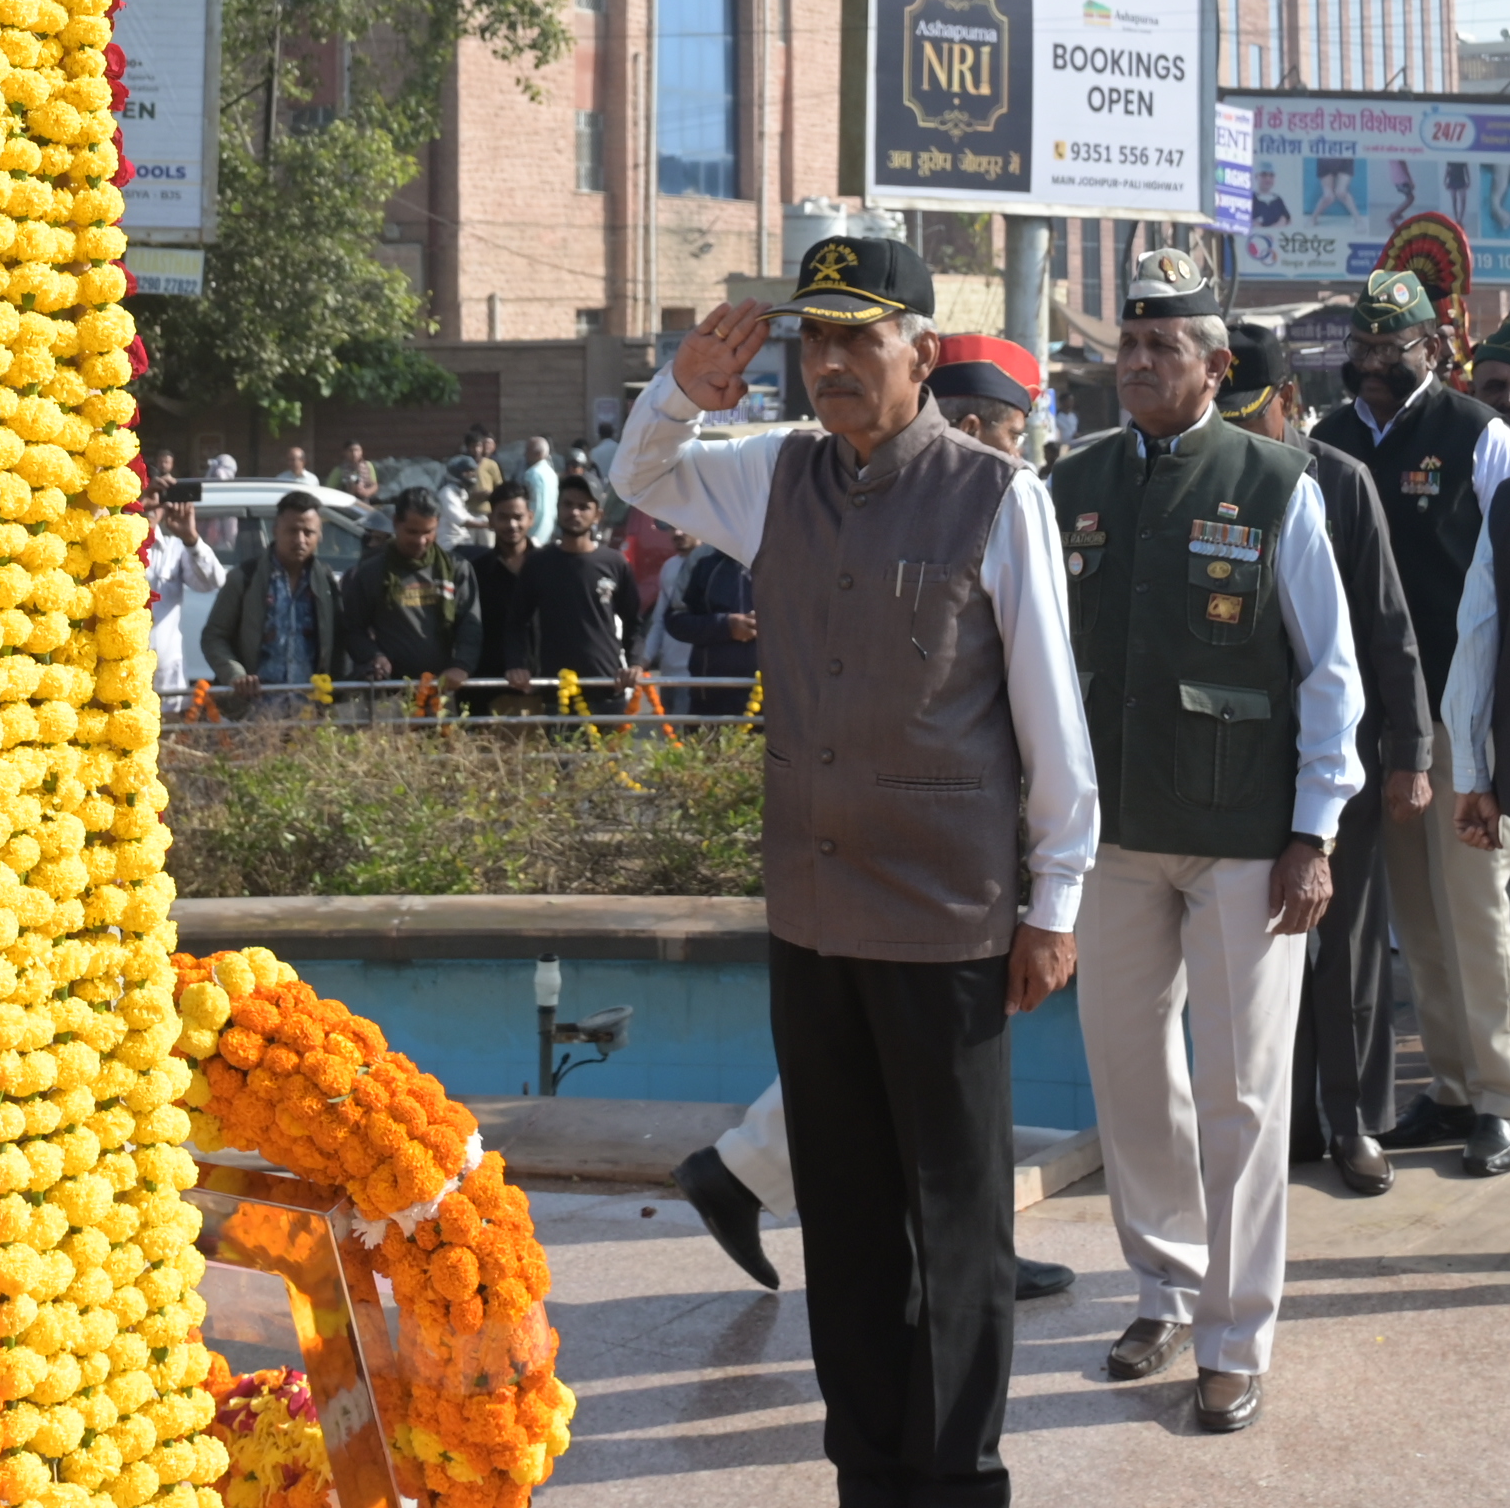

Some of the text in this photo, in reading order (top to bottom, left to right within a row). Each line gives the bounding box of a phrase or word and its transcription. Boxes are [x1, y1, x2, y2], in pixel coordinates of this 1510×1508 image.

[1052, 43, 1185, 82] BOOKINGS
[122, 101, 156, 120] EN
[1087, 85, 1154, 118] OPEN
[1329, 107, 1356, 132] रोग
[1215, 125, 1250, 152] ENT
[1431, 121, 1466, 142] 24/7
[1070, 142, 1184, 168] 9351 556 747
[1254, 134, 1302, 155] .हितेश
[136, 164, 187, 180] OOLS
[1051, 174, 1075, 186] MAIN
